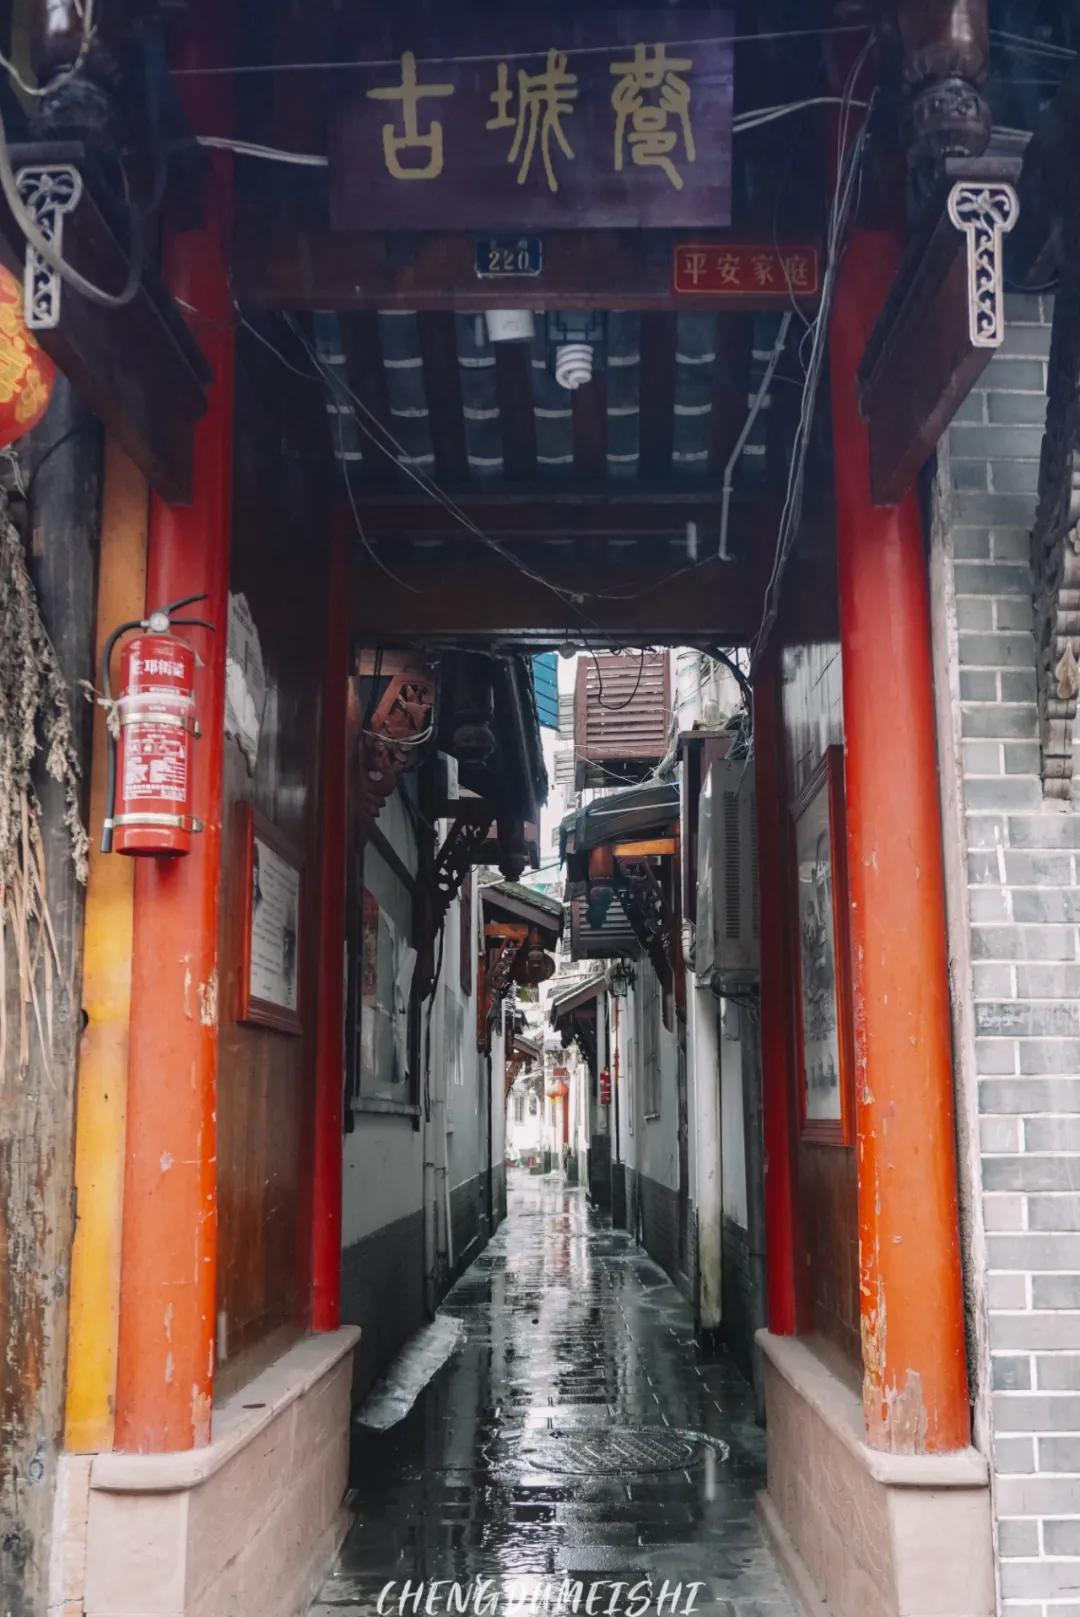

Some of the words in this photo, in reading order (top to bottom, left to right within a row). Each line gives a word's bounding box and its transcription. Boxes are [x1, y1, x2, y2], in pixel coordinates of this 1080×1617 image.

[488, 250, 531, 271] 220
[682, 252, 809, 287] 平安家庭
